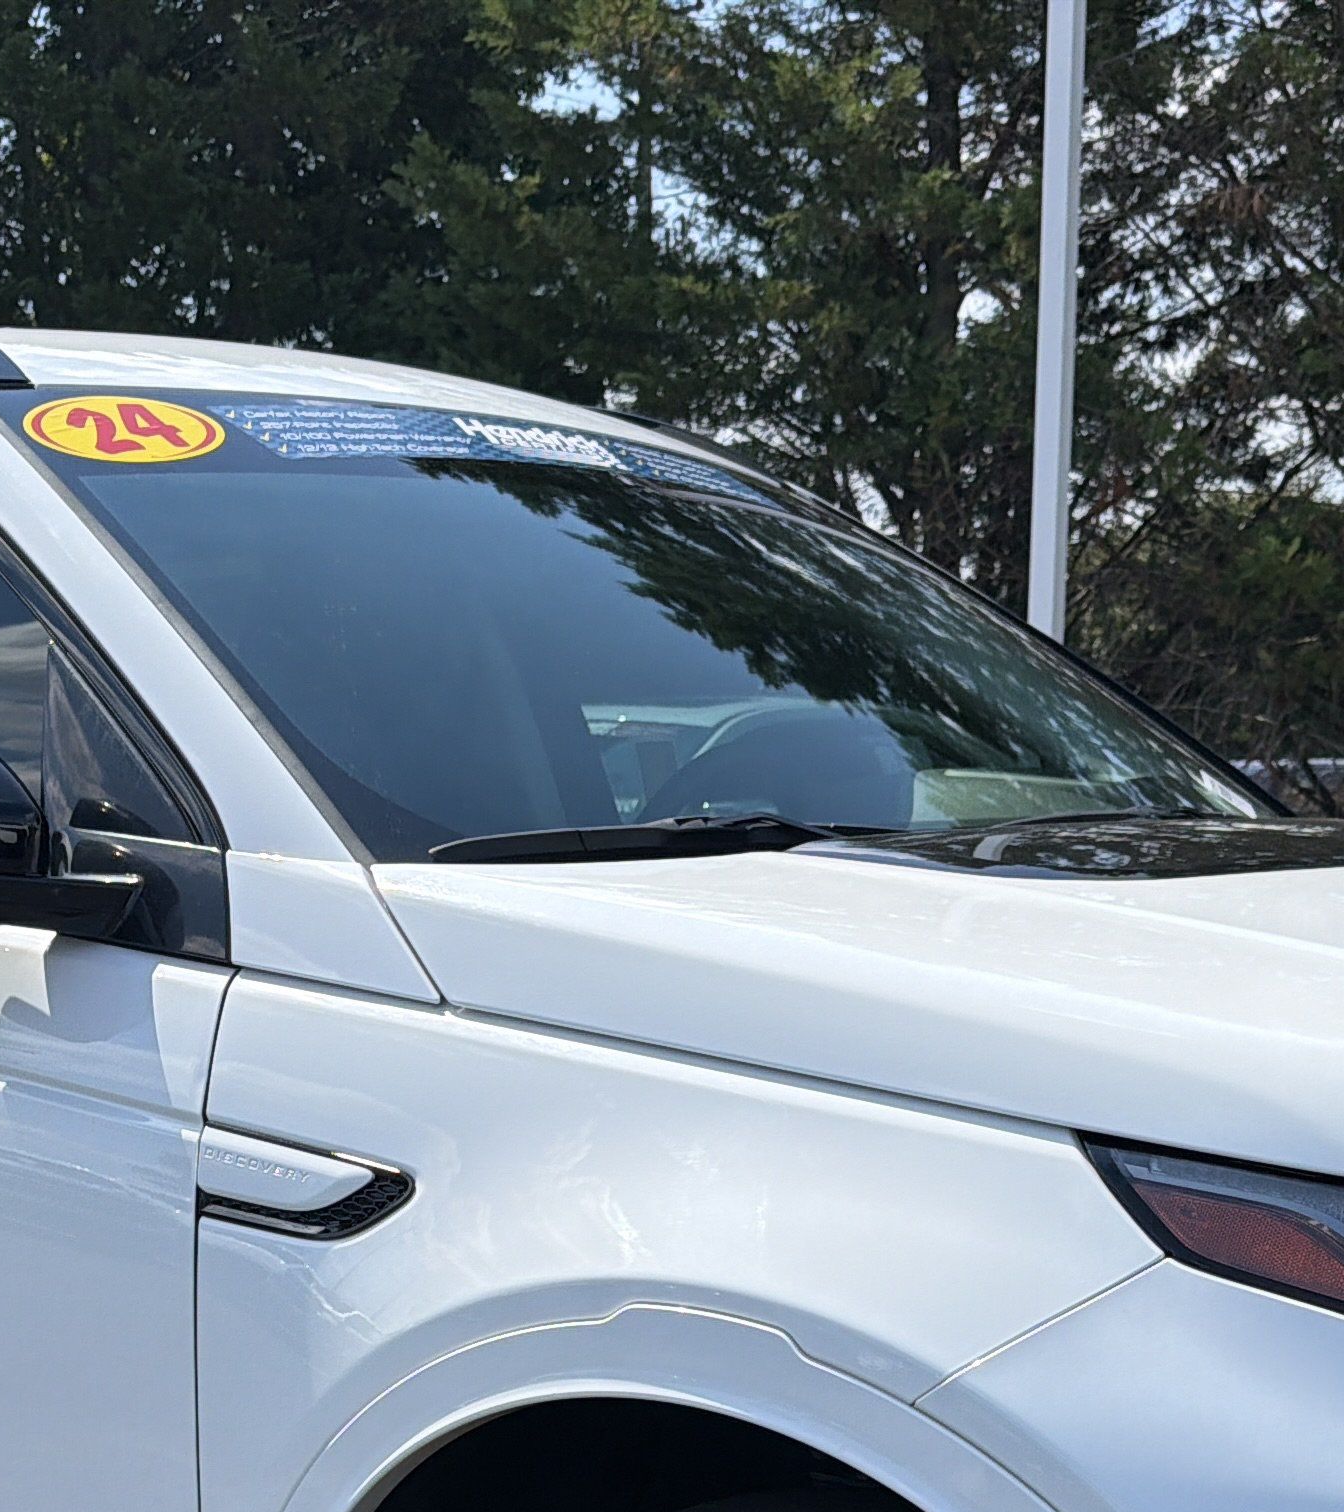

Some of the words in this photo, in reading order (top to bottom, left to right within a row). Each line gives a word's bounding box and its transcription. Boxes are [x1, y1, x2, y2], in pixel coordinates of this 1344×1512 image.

[65, 403, 191, 455] 24
[280, 432, 331, 441] 10/100
[204, 1146, 311, 1184] DISCOVERY
